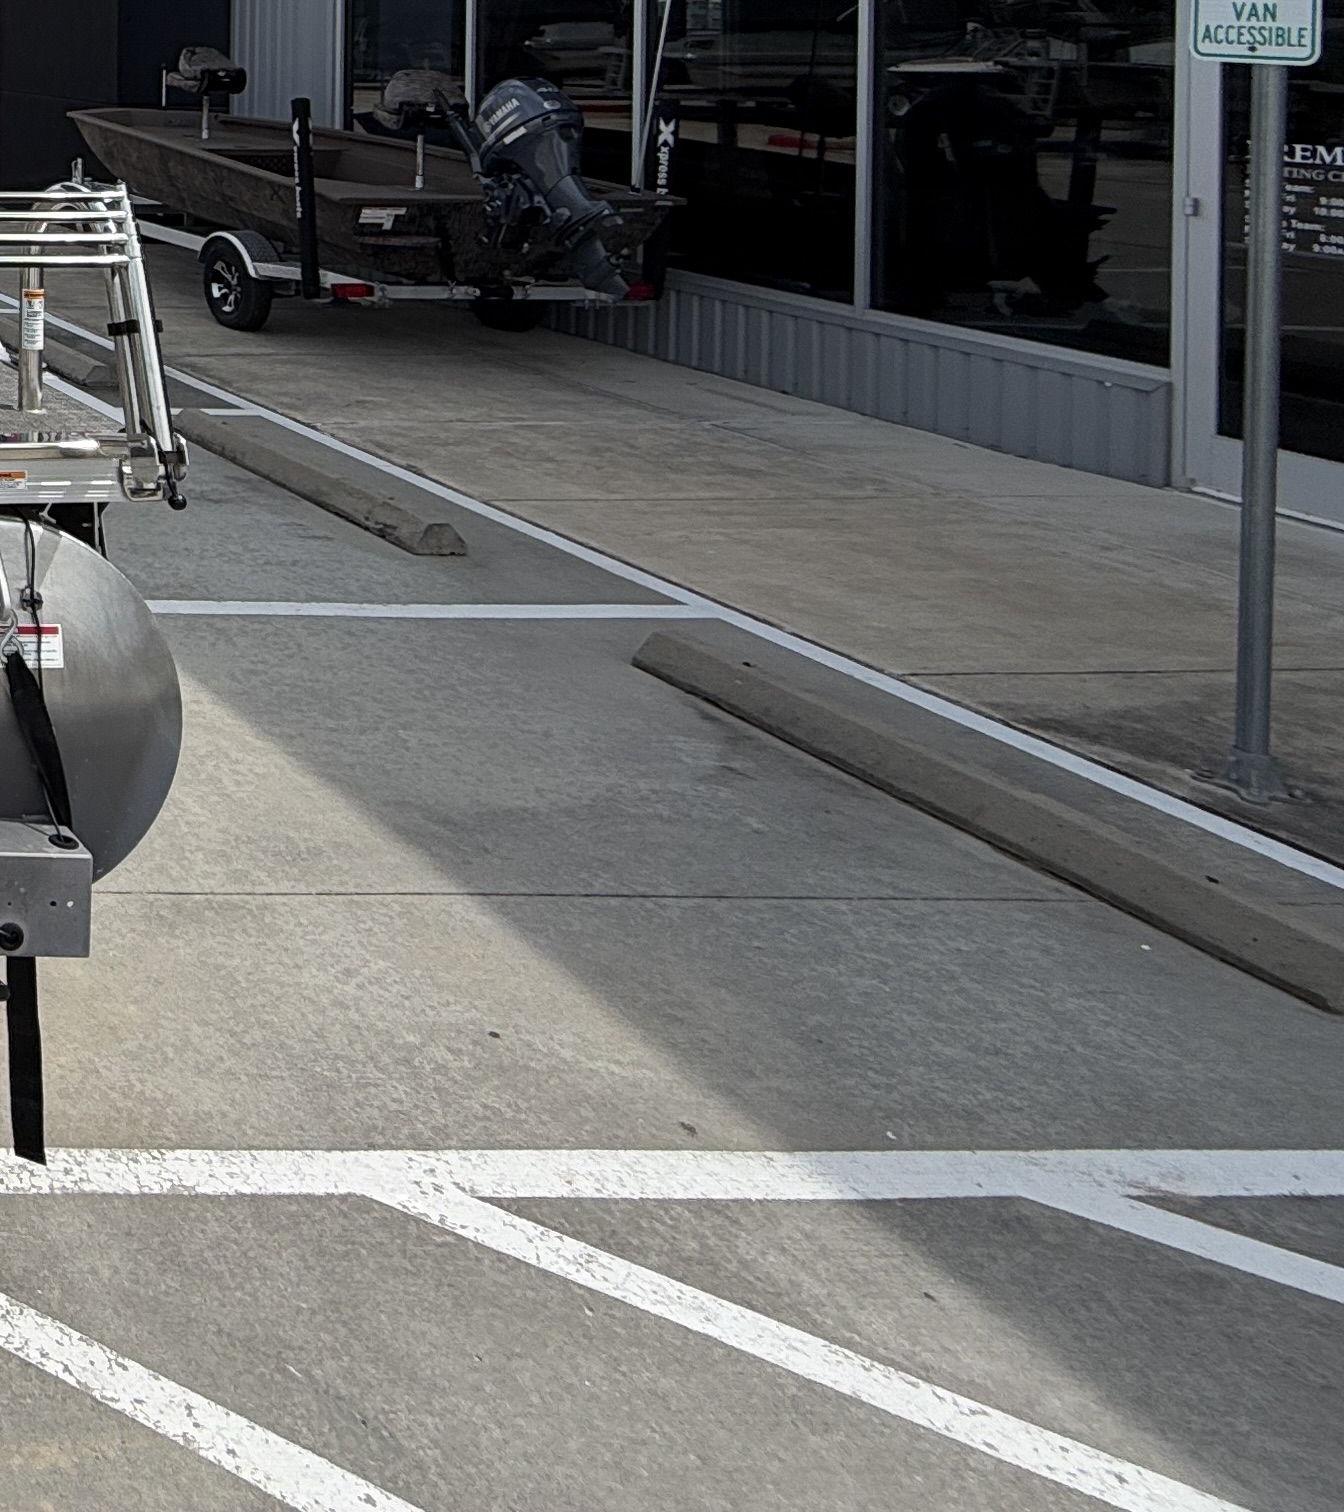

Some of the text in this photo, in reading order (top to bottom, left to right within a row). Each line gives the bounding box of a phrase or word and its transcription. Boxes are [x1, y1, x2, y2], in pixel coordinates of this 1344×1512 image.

[1232, 1, 1278, 22] VAN
[1201, 24, 1308, 48] ACCESSIBLE
[488, 98, 521, 126] YAMAHA
